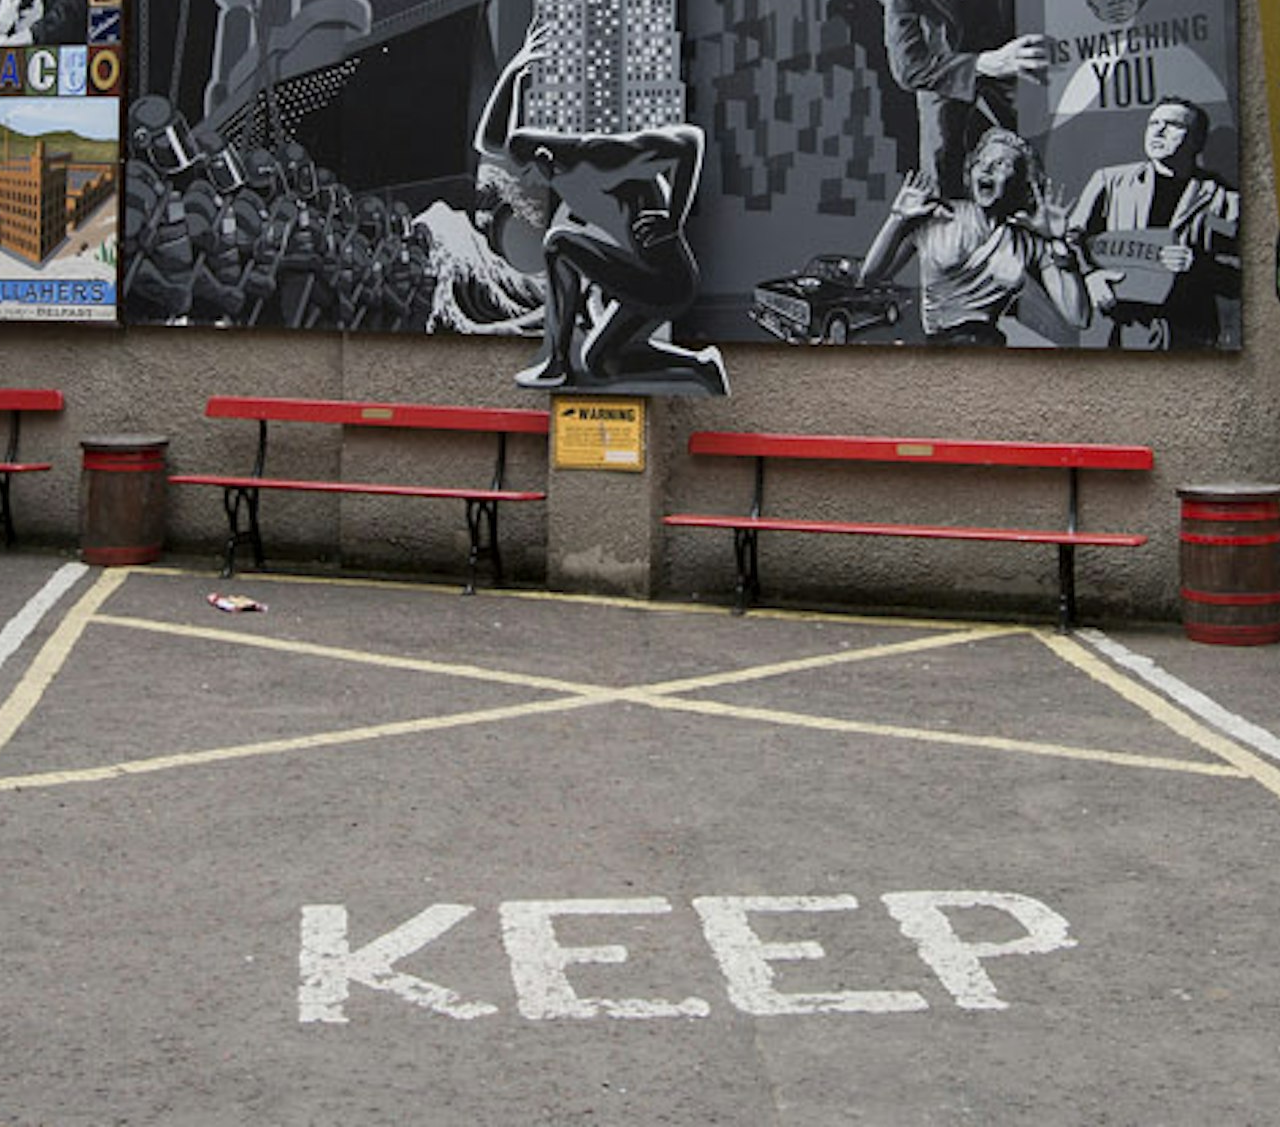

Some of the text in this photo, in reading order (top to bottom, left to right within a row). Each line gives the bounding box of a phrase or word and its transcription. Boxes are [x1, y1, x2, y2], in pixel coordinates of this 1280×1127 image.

[1050, 14, 1208, 65] IS WATCHING
[1092, 56, 1156, 109] YOU
[579, 408, 635, 423] WARNING
[297, 890, 1078, 1024] KEEP
